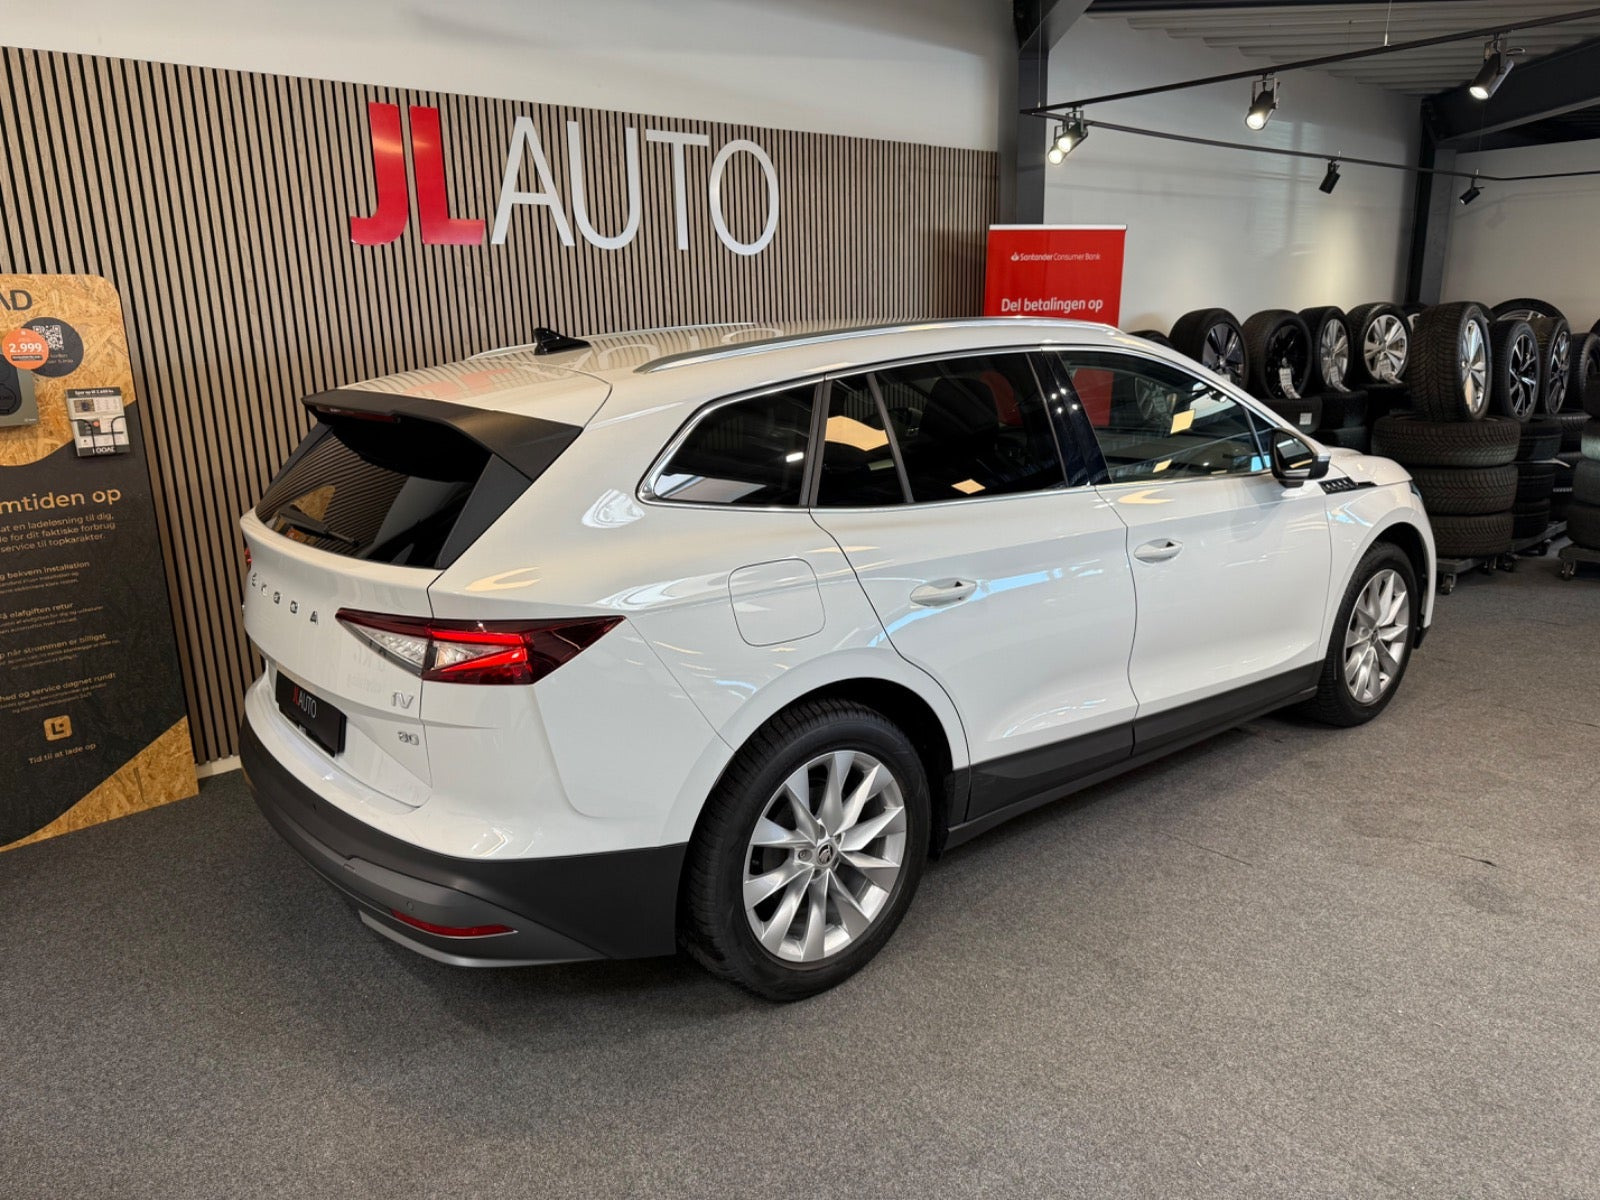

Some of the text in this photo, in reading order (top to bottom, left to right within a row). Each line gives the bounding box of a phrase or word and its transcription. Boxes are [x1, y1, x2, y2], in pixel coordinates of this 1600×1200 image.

[491, 116, 779, 256] AUTO
[1020, 252, 1101, 261] Santander Consumer Bank
[1001, 297, 1104, 314] Del betalingen op
[8, 342, 43, 353] 2.999
[92, 488, 121, 505] op
